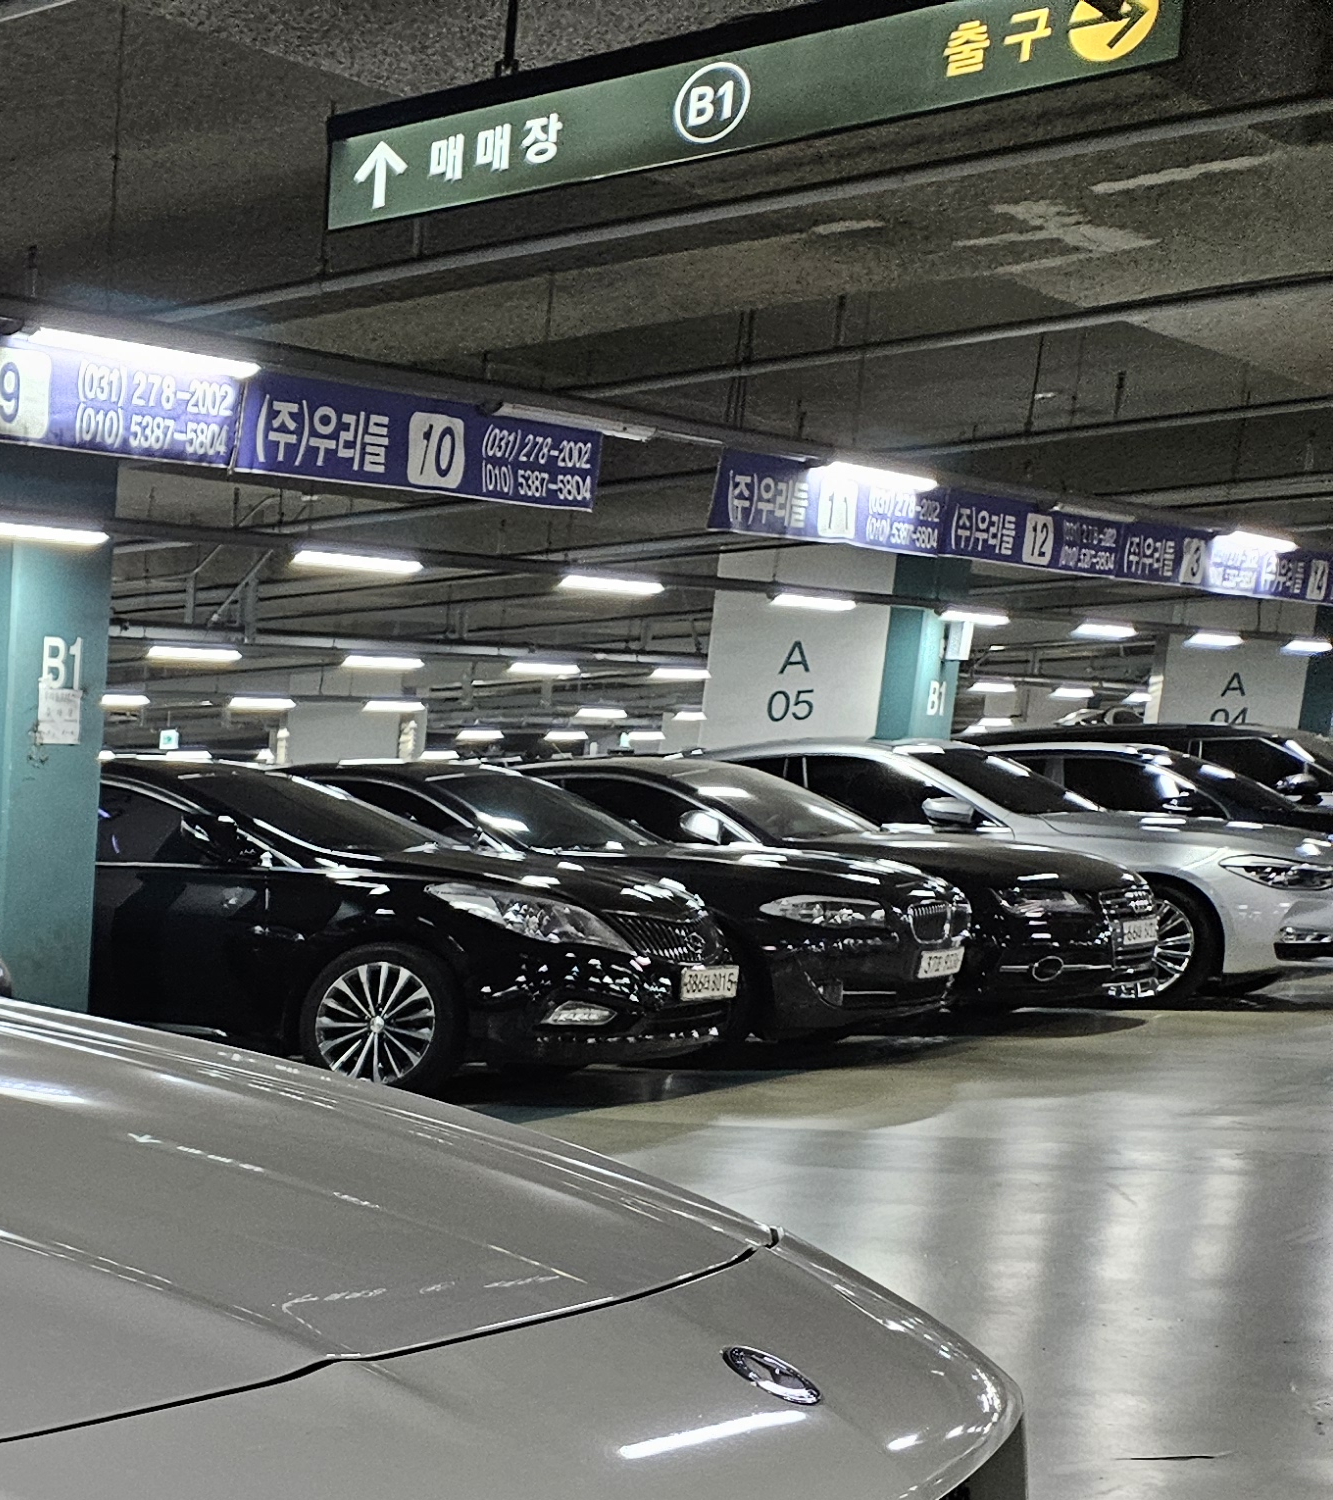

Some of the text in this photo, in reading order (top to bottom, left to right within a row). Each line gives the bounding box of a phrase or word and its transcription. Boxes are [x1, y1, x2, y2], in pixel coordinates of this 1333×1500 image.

[943, 7, 1052, 77] 출구
[687, 79, 737, 128] B1
[428, 113, 563, 182] 매매장
[78, 359, 233, 416] (031) 278-2002
[75, 402, 229, 456] (010) 5387-5804
[256, 394, 389, 473] (주)우리들
[420, 423, 456, 479] 10
[482, 424, 592, 469] (031) 278-2002
[482, 460, 592, 501] (010) 5387-5804
[728, 469, 809, 529] (주)우리들
[951, 503, 1016, 555] (주)우리들
[1031, 520, 1049, 558] 12
[1124, 535, 1175, 577] (주)우리들
[42, 636, 83, 690] B1
[777, 640, 810, 675] A
[767, 689, 814, 722] 05
[926, 681, 947, 716] B1
[1221, 672, 1245, 697] A
